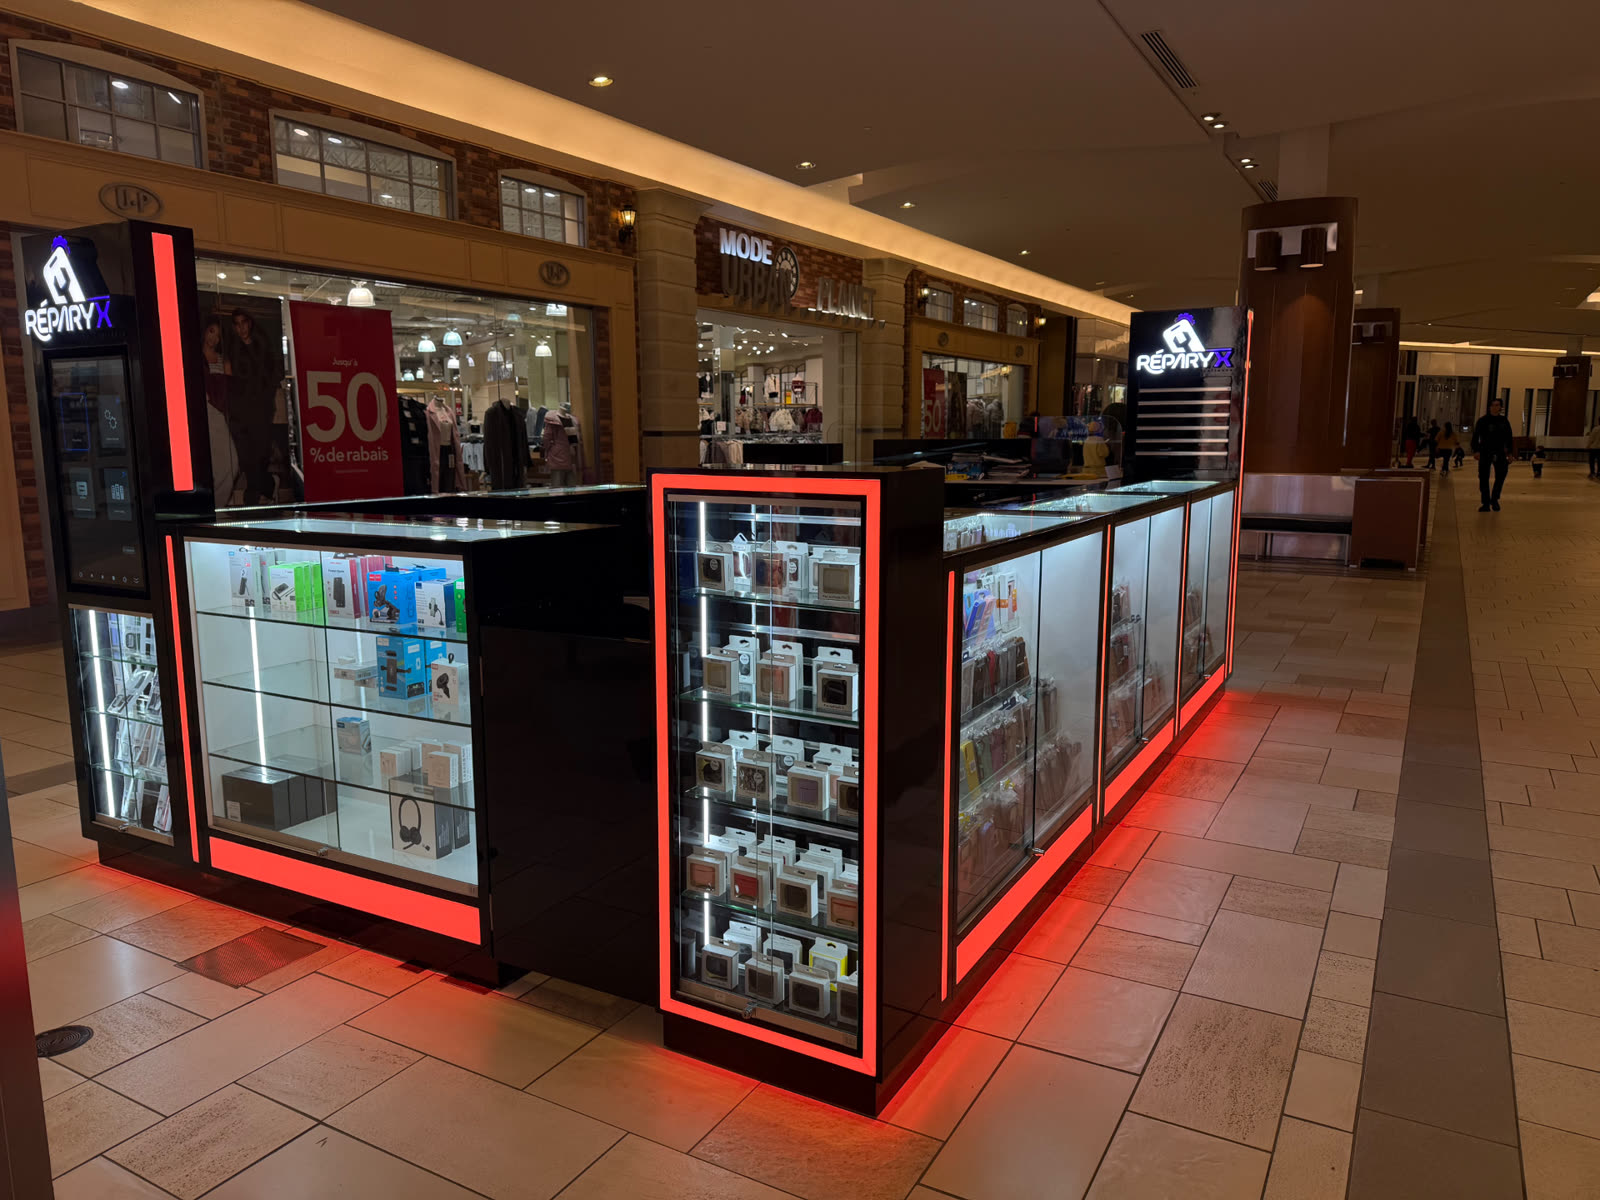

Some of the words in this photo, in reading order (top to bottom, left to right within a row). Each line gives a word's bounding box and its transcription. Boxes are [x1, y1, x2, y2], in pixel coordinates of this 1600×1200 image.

[719, 227, 773, 266] MODE
[720, 253, 793, 307] URBAN
[306, 370, 388, 443] 50
[924, 399, 942, 433] 50
[327, 446, 345, 462] de
[347, 446, 388, 462] rabais
